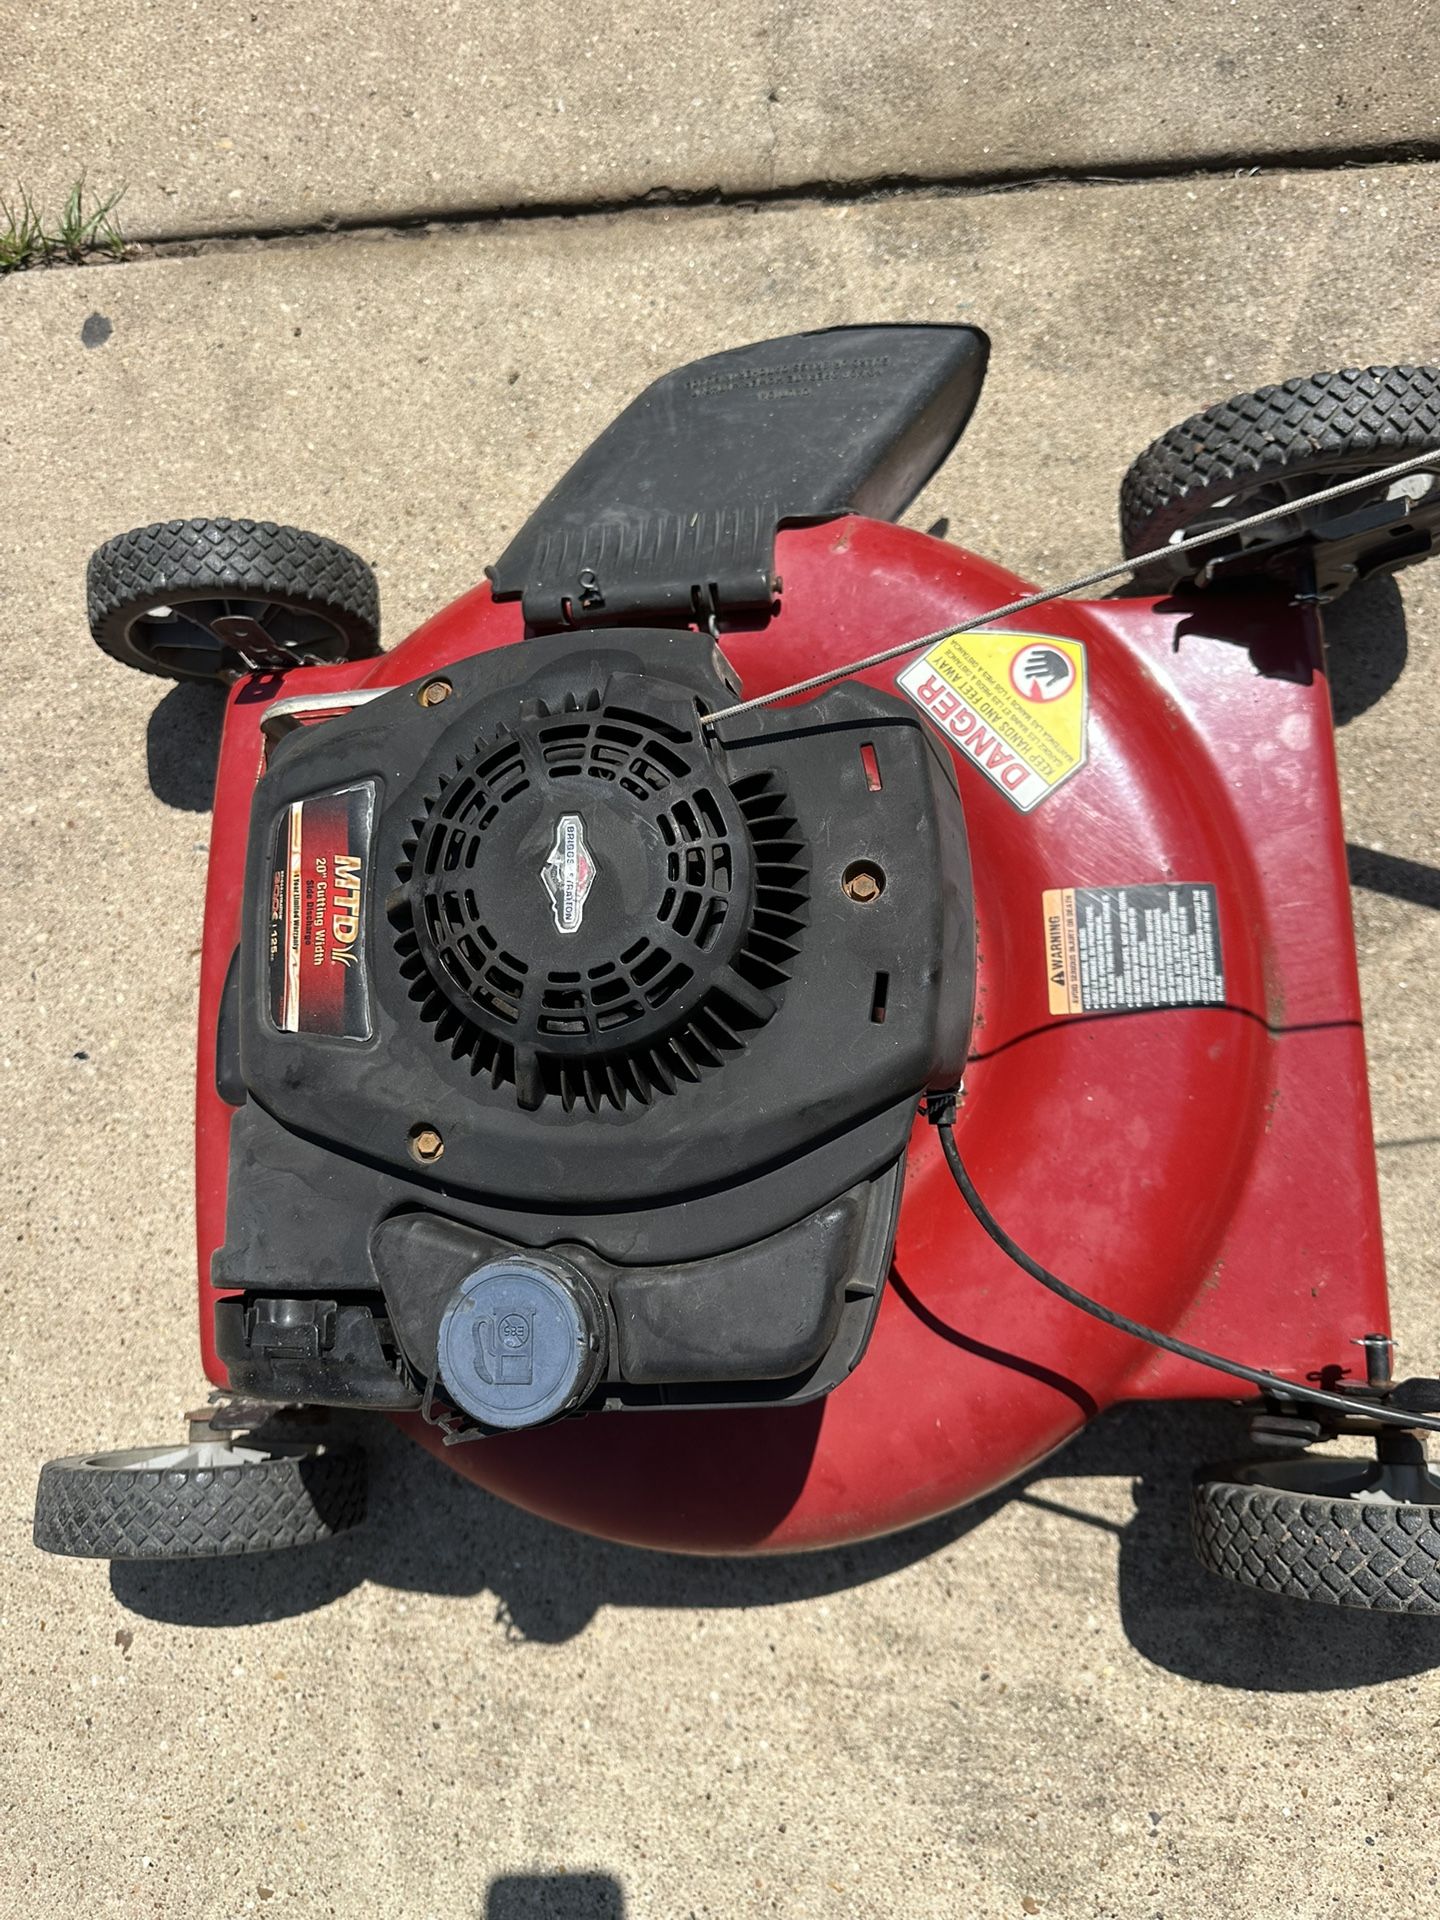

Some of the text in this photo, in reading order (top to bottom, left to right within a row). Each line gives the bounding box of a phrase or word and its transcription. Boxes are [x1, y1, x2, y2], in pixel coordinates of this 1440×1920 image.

[916, 675, 1030, 790] DANGER
[933, 656, 1056, 776] KEEP HANDS AND FEET AWAY
[566, 826, 575, 863] BRIGGS
[305, 879, 314, 945] Side Discharge
[314, 881, 327, 926] Cutting
[333, 854, 361, 943] MTD
[1065, 895, 1073, 916] DEATH
[1048, 916, 1063, 969] WARNING
[1067, 918, 1073, 927] OR
[314, 929, 325, 965] Width
[1069, 953, 1077, 981] SERIOUS
[504, 1325, 524, 1336] E85
